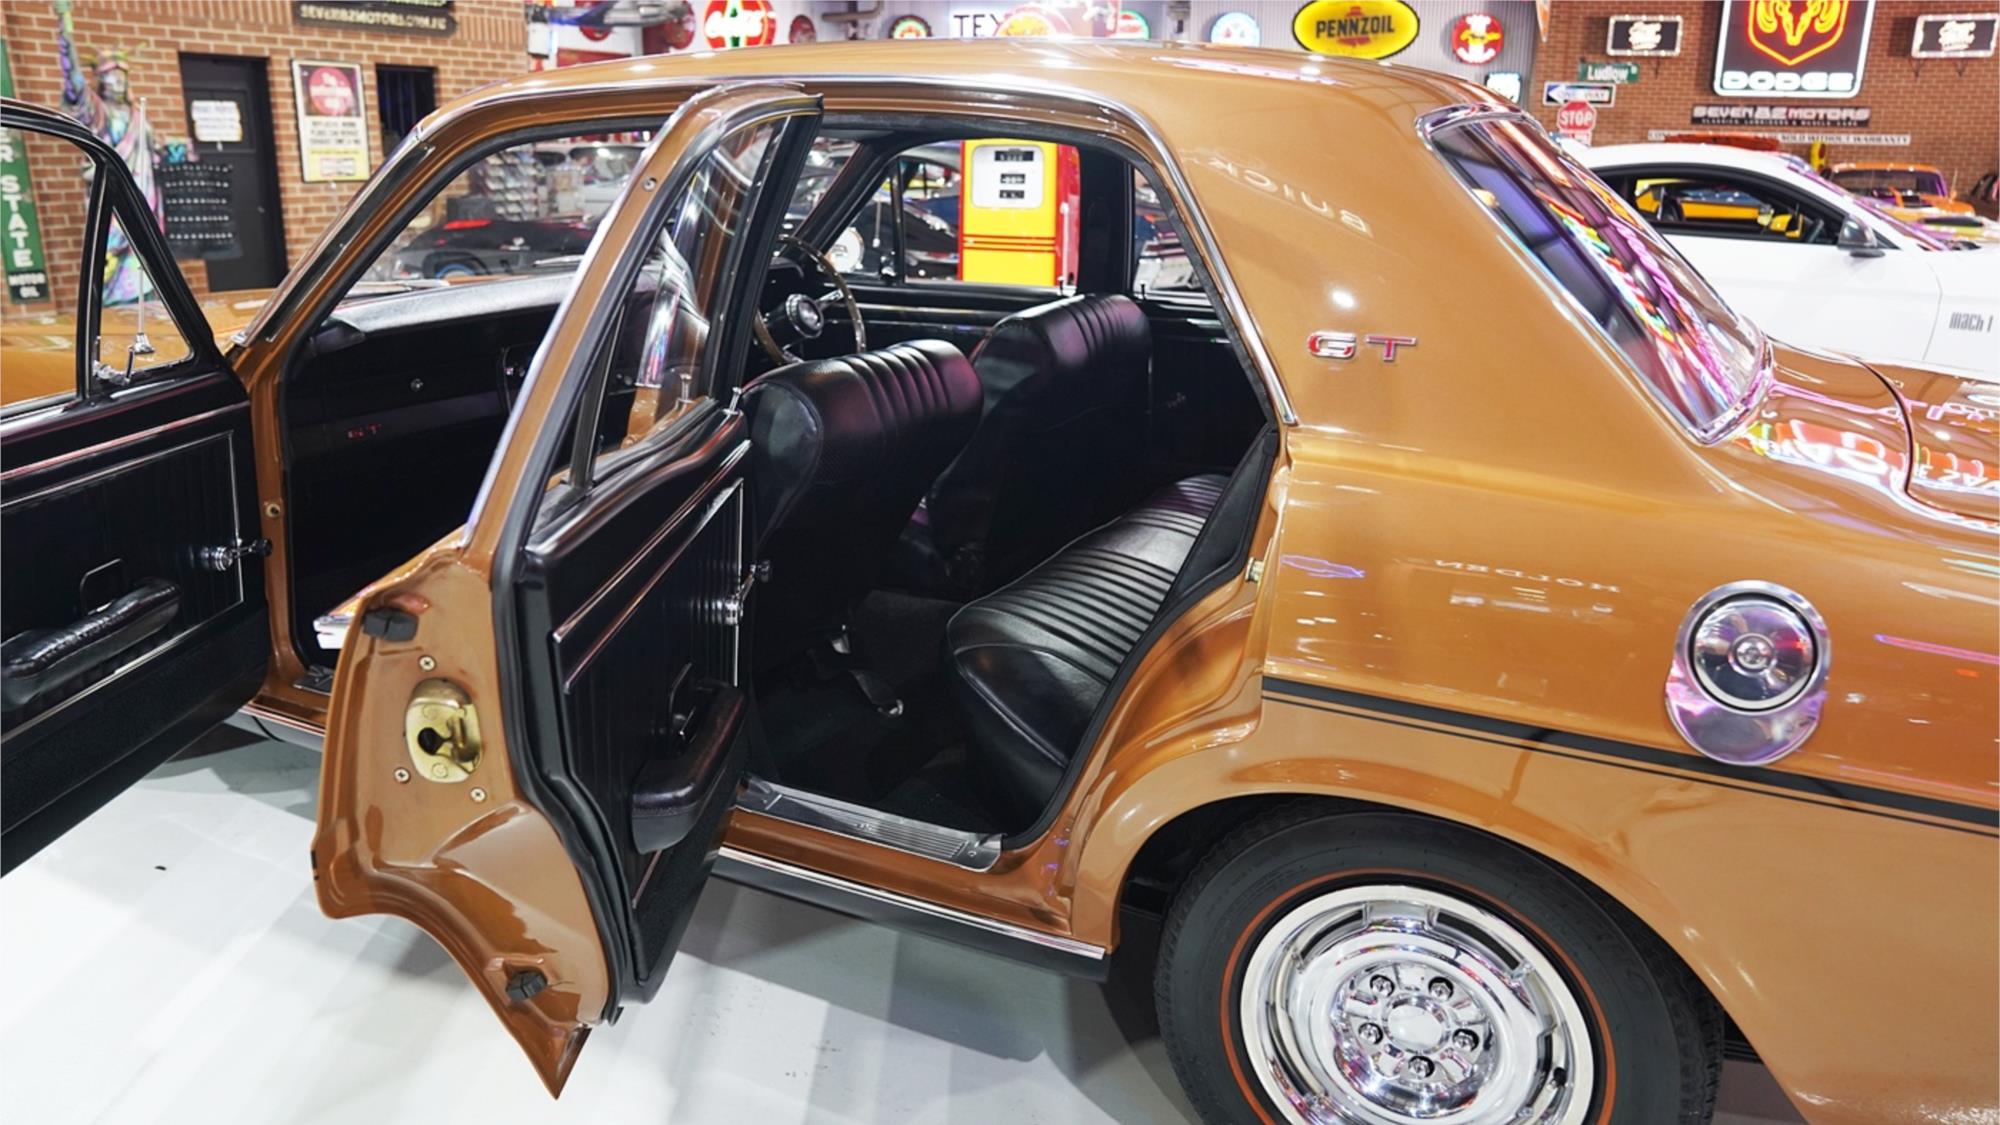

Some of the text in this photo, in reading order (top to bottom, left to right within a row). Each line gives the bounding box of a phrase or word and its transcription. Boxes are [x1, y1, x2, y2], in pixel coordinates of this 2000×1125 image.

[1315, 15, 1395, 38] PENNZOIL
[1587, 65, 1628, 83] Ludlow
[1722, 71, 1854, 91] DODGE
[1560, 110, 1593, 126] STOP
[1, 174, 34, 268] STATE
[1307, 331, 1416, 361] GT
